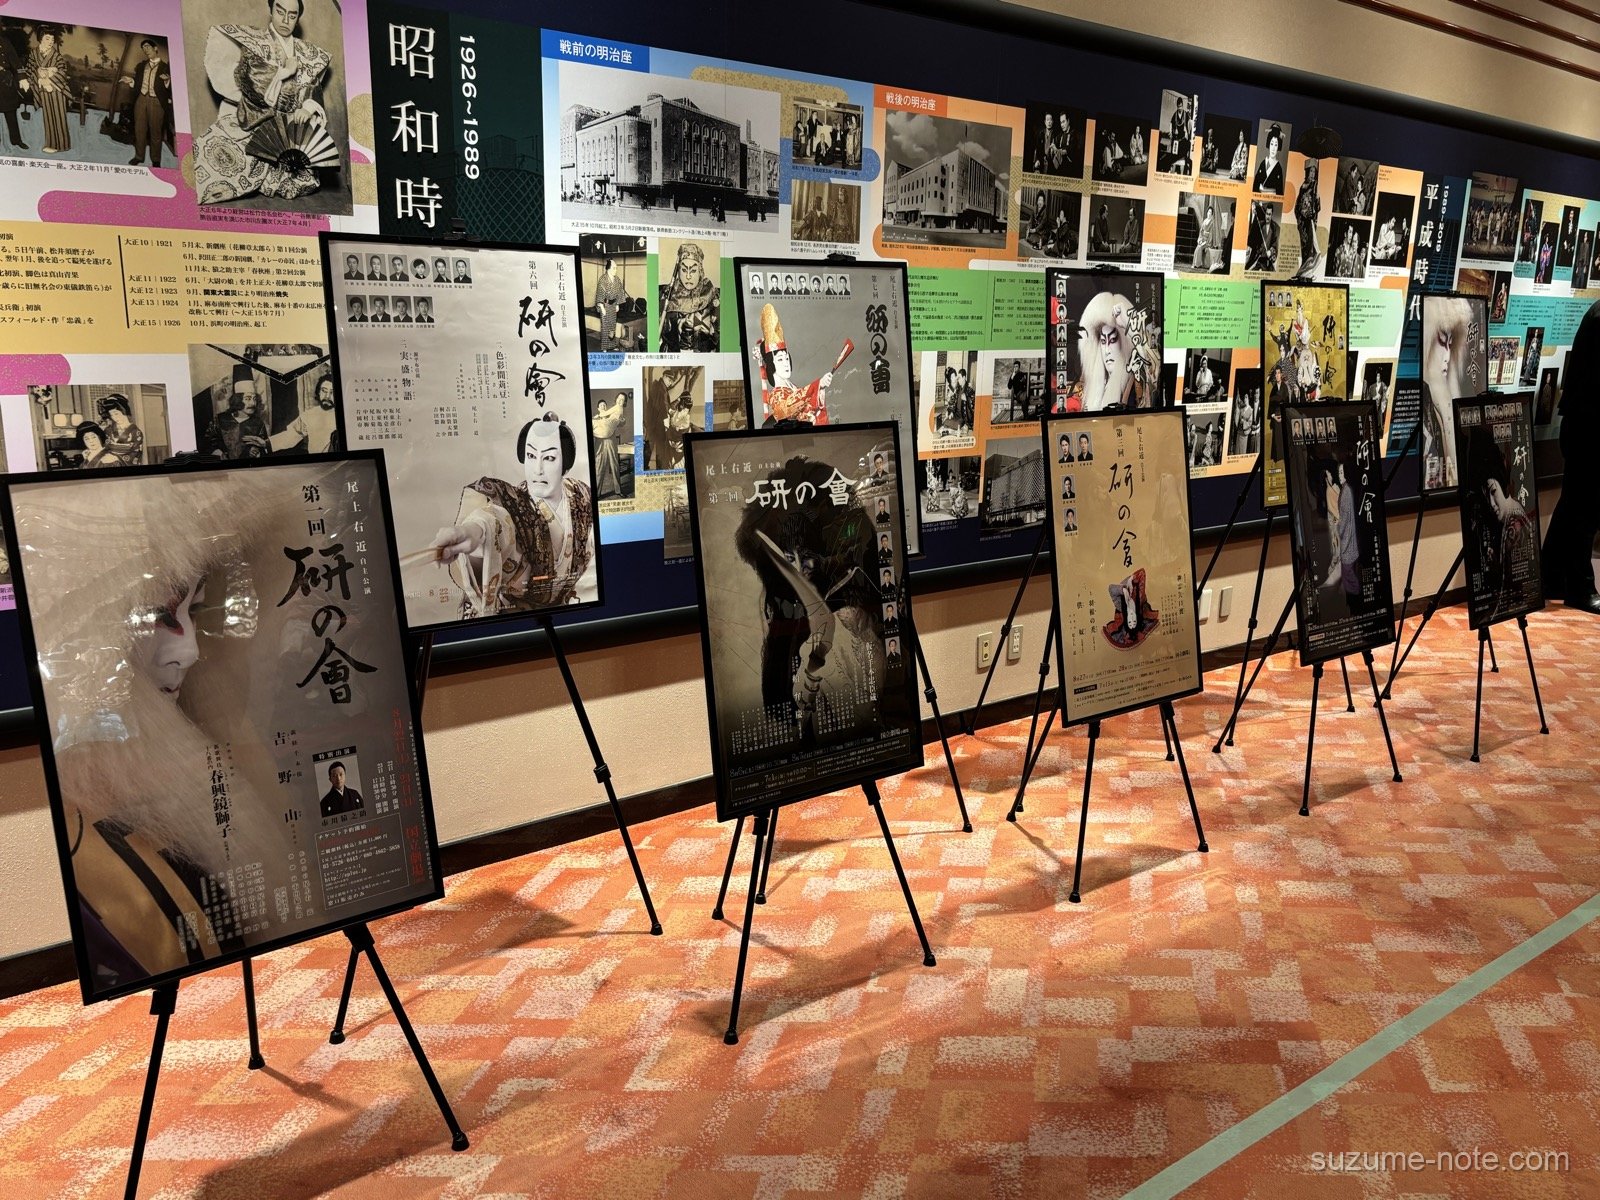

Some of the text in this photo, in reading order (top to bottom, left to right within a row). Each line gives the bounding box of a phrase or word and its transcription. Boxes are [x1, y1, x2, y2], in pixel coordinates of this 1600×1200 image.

[559, 39, 633, 65] 戦前の明治座
[885, 91, 937, 111] 戦後の明治座
[528, 260, 538, 289] 第六回
[162, 299, 179, 307] 1924
[705, 461, 752, 476] 尾上右近
[708, 468, 857, 510] 第二回 研の會
[302, 484, 326, 536] 第一回
[346, 481, 372, 595] 尾上右近 自主公演
